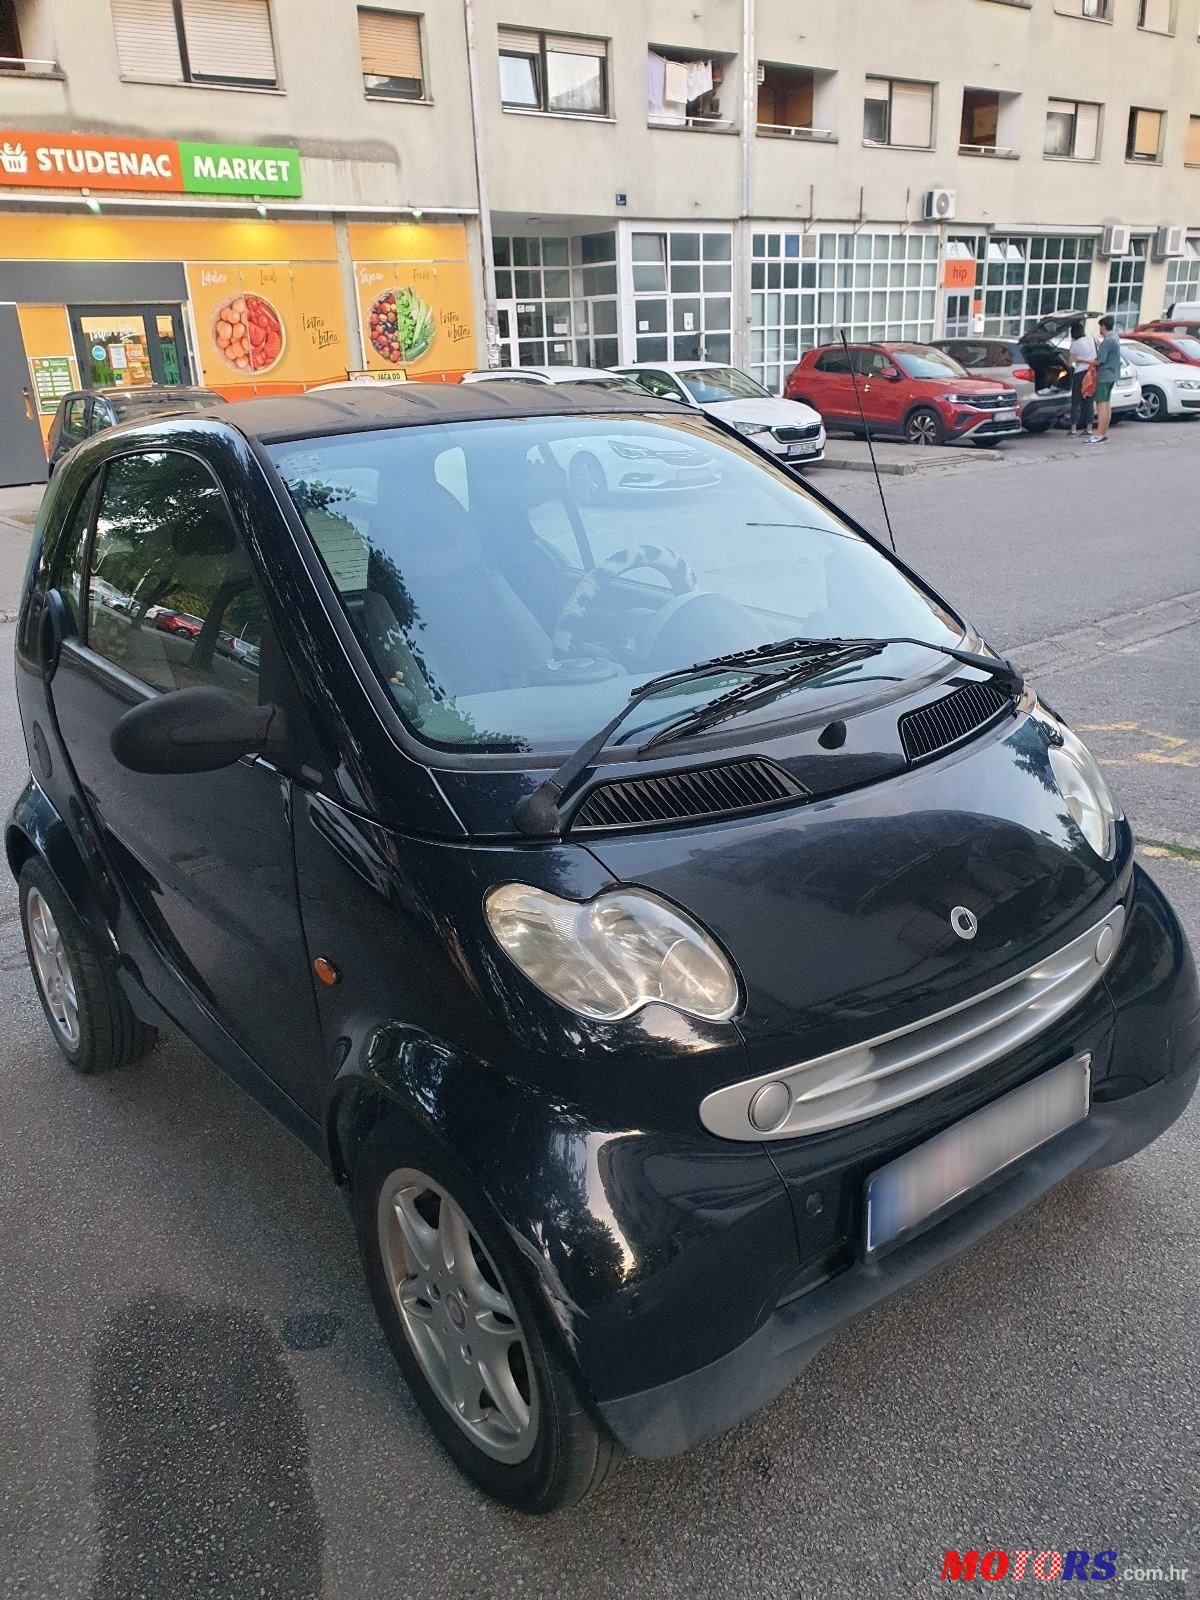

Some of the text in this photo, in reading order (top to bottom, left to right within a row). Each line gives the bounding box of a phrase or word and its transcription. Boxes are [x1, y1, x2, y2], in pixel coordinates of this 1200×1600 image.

[35, 147, 290, 182] STUDENAC MARKET
[952, 265, 968, 281] hip
